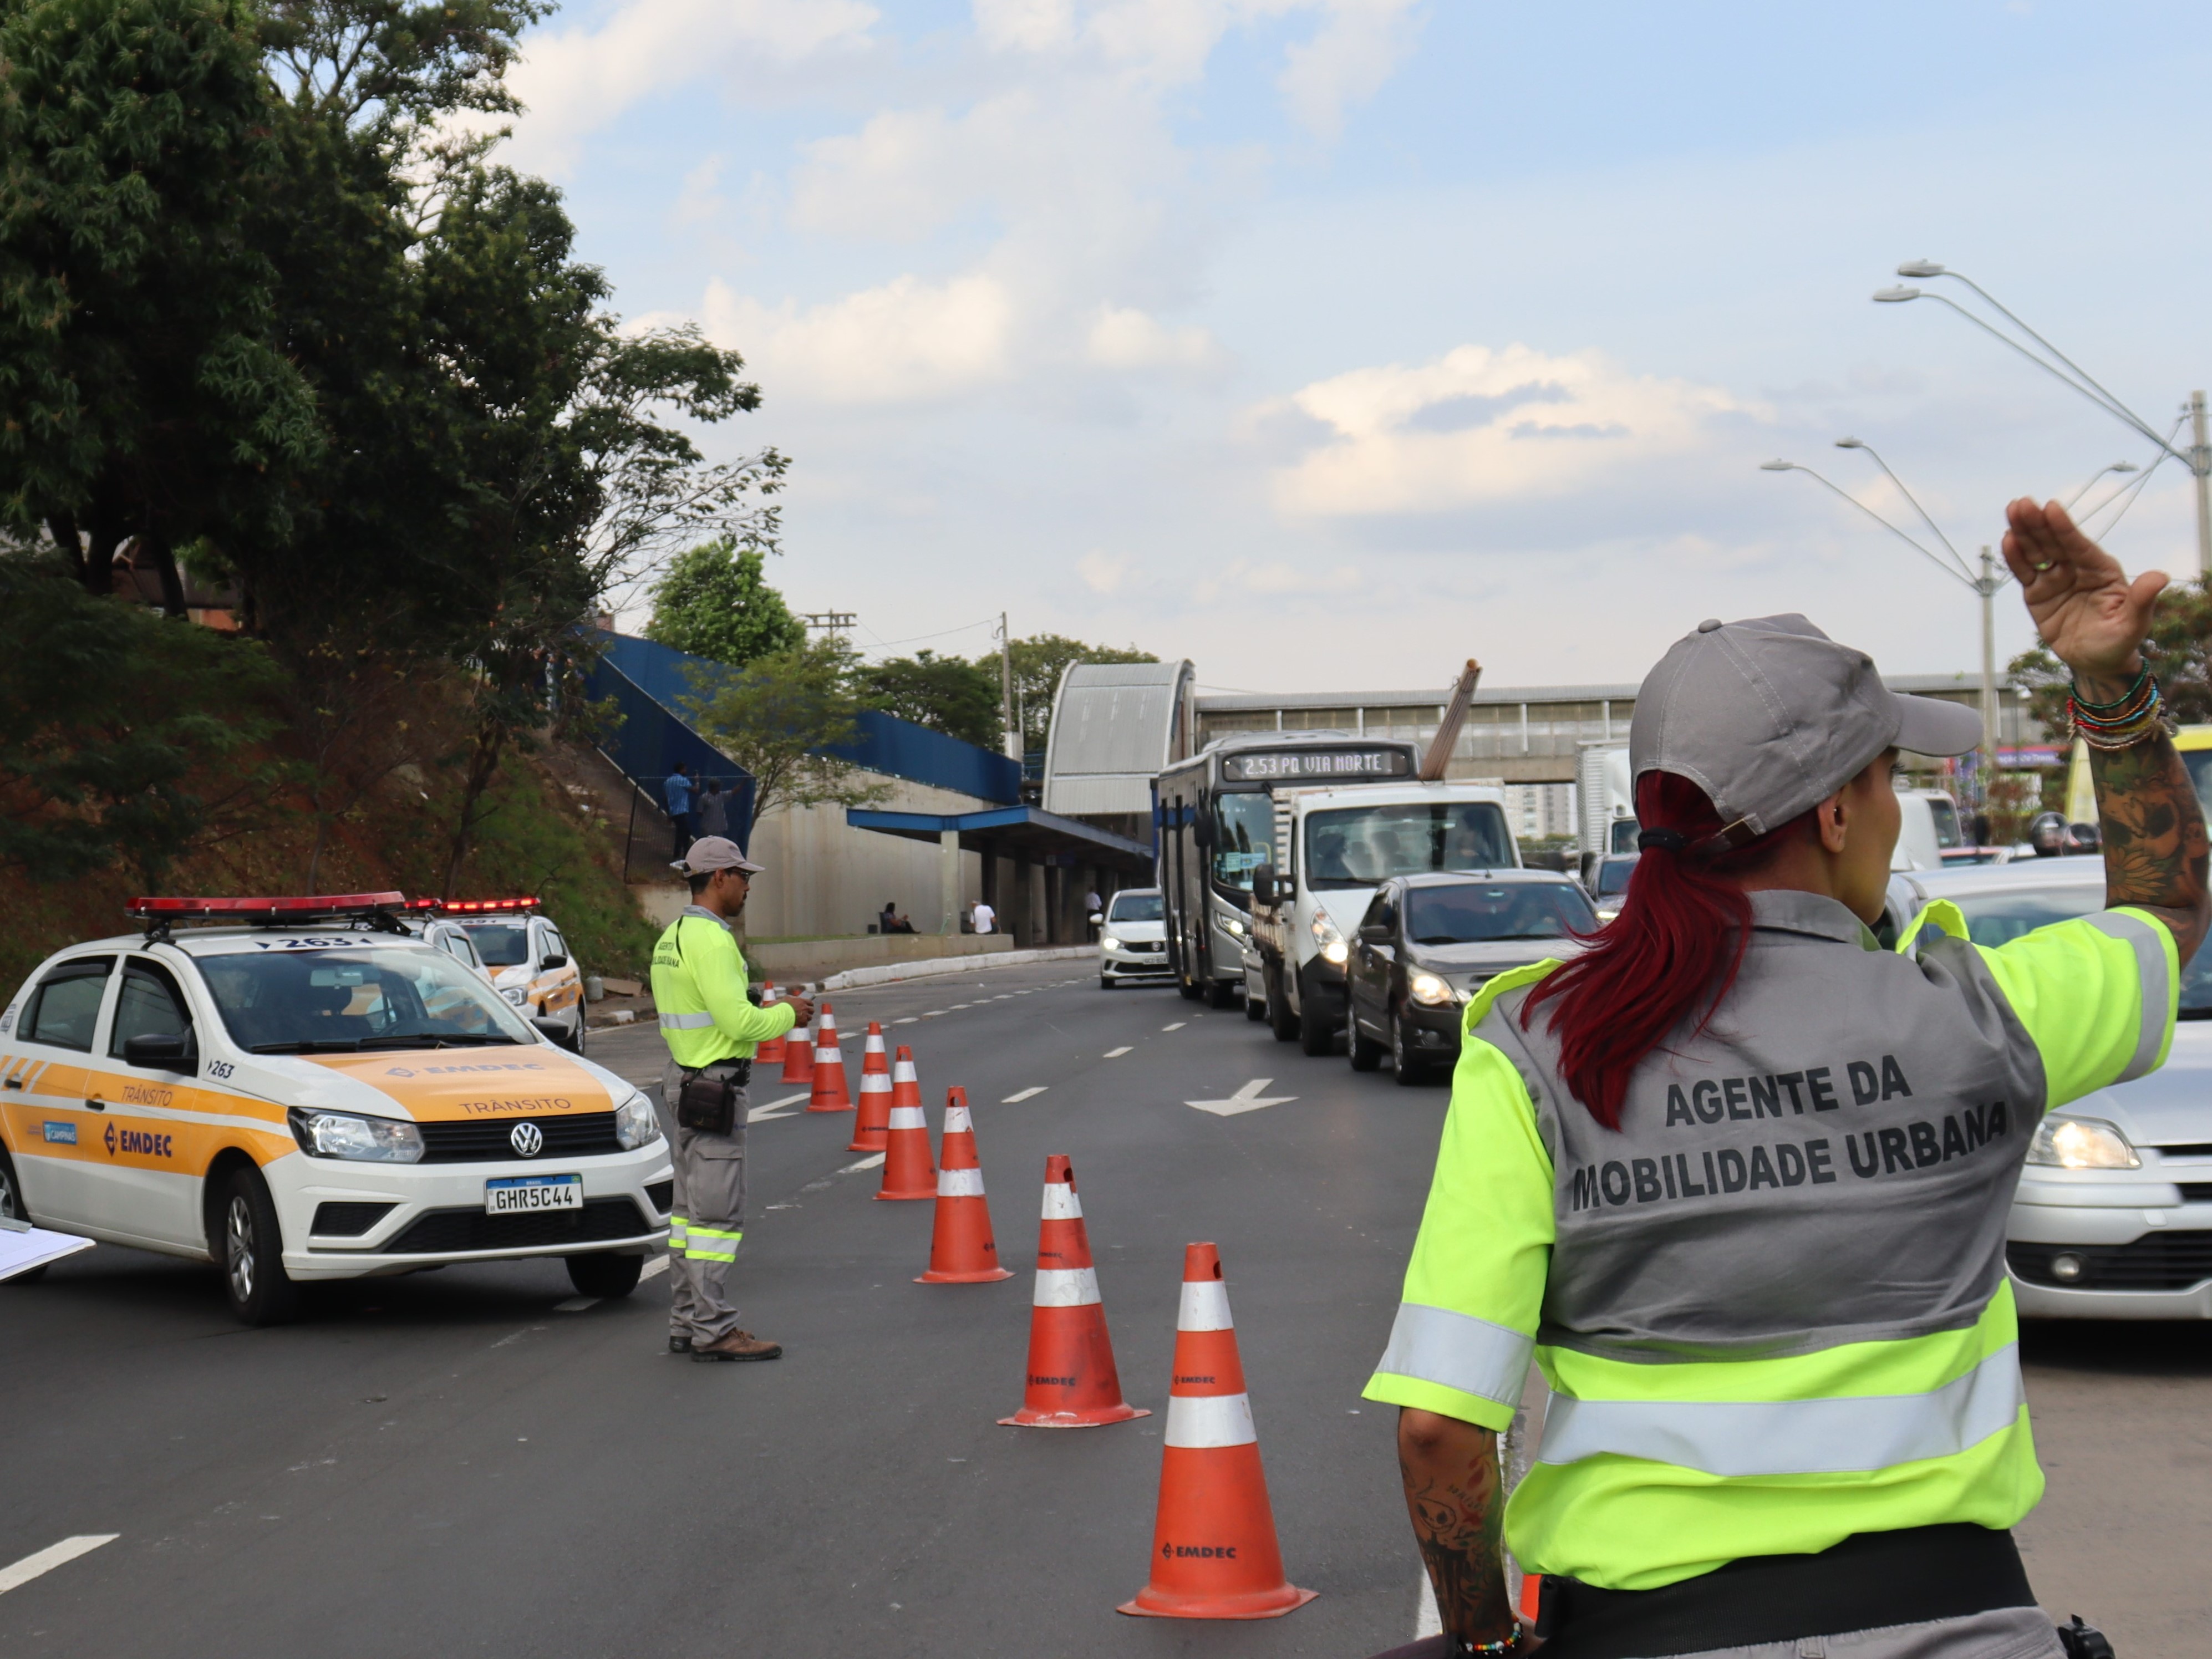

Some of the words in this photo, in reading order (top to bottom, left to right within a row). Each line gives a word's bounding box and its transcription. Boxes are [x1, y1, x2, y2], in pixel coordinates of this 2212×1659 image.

[1245, 758, 1277, 774] 2.53
[1282, 757, 1300, 773] PQ
[1305, 756, 1331, 772] VIA
[278, 938, 353, 948] 263
[211, 1060, 235, 1079] 263
[424, 1063, 546, 1074] EMDEC
[121, 1084, 173, 1107] TRÂNSITO
[1665, 1067, 1839, 1127] AGENTE
[1847, 1055, 1913, 1106] DA
[459, 1098, 571, 1115] TRÂNSITO
[120, 1129, 172, 1158] EMDEC
[1573, 1138, 1837, 1211] MOBILIDADE
[1844, 1101, 2007, 1179] URBANA
[496, 1187, 573, 1209] GHR5C44
[1035, 1376, 1076, 1387] EMDEC
[1181, 1376, 1216, 1385] EMDEC
[1176, 1546, 1237, 1559] EMDEC
